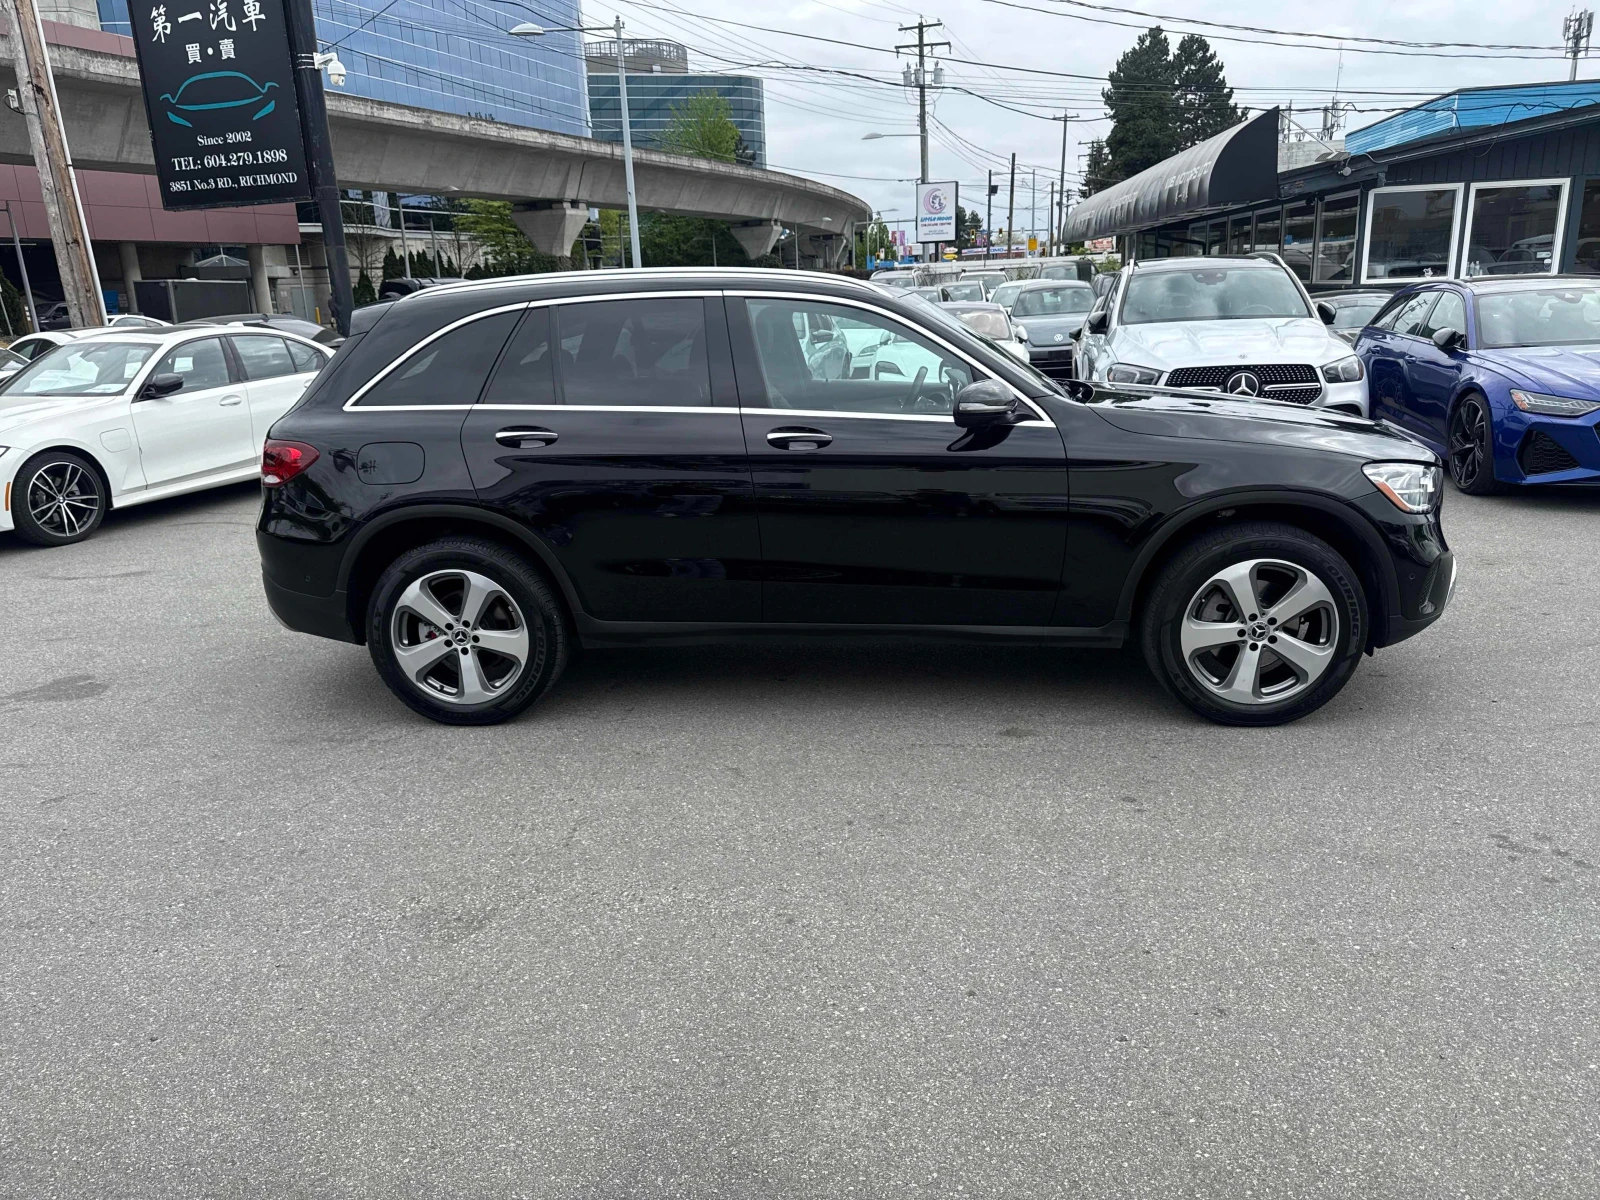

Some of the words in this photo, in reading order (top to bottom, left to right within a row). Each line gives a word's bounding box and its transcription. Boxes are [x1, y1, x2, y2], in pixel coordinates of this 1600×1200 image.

[150, 0, 266, 43] 第一汽車
[197, 134, 225, 147] Since
[226, 130, 252, 144] 2002
[171, 156, 202, 171] TEL:
[204, 148, 288, 169] 604.279.1898
[169, 181, 192, 193] 3851
[194, 178, 216, 190] No.3
[239, 172, 298, 187] RICHMOND
[513, 622, 544, 702] TOURING
